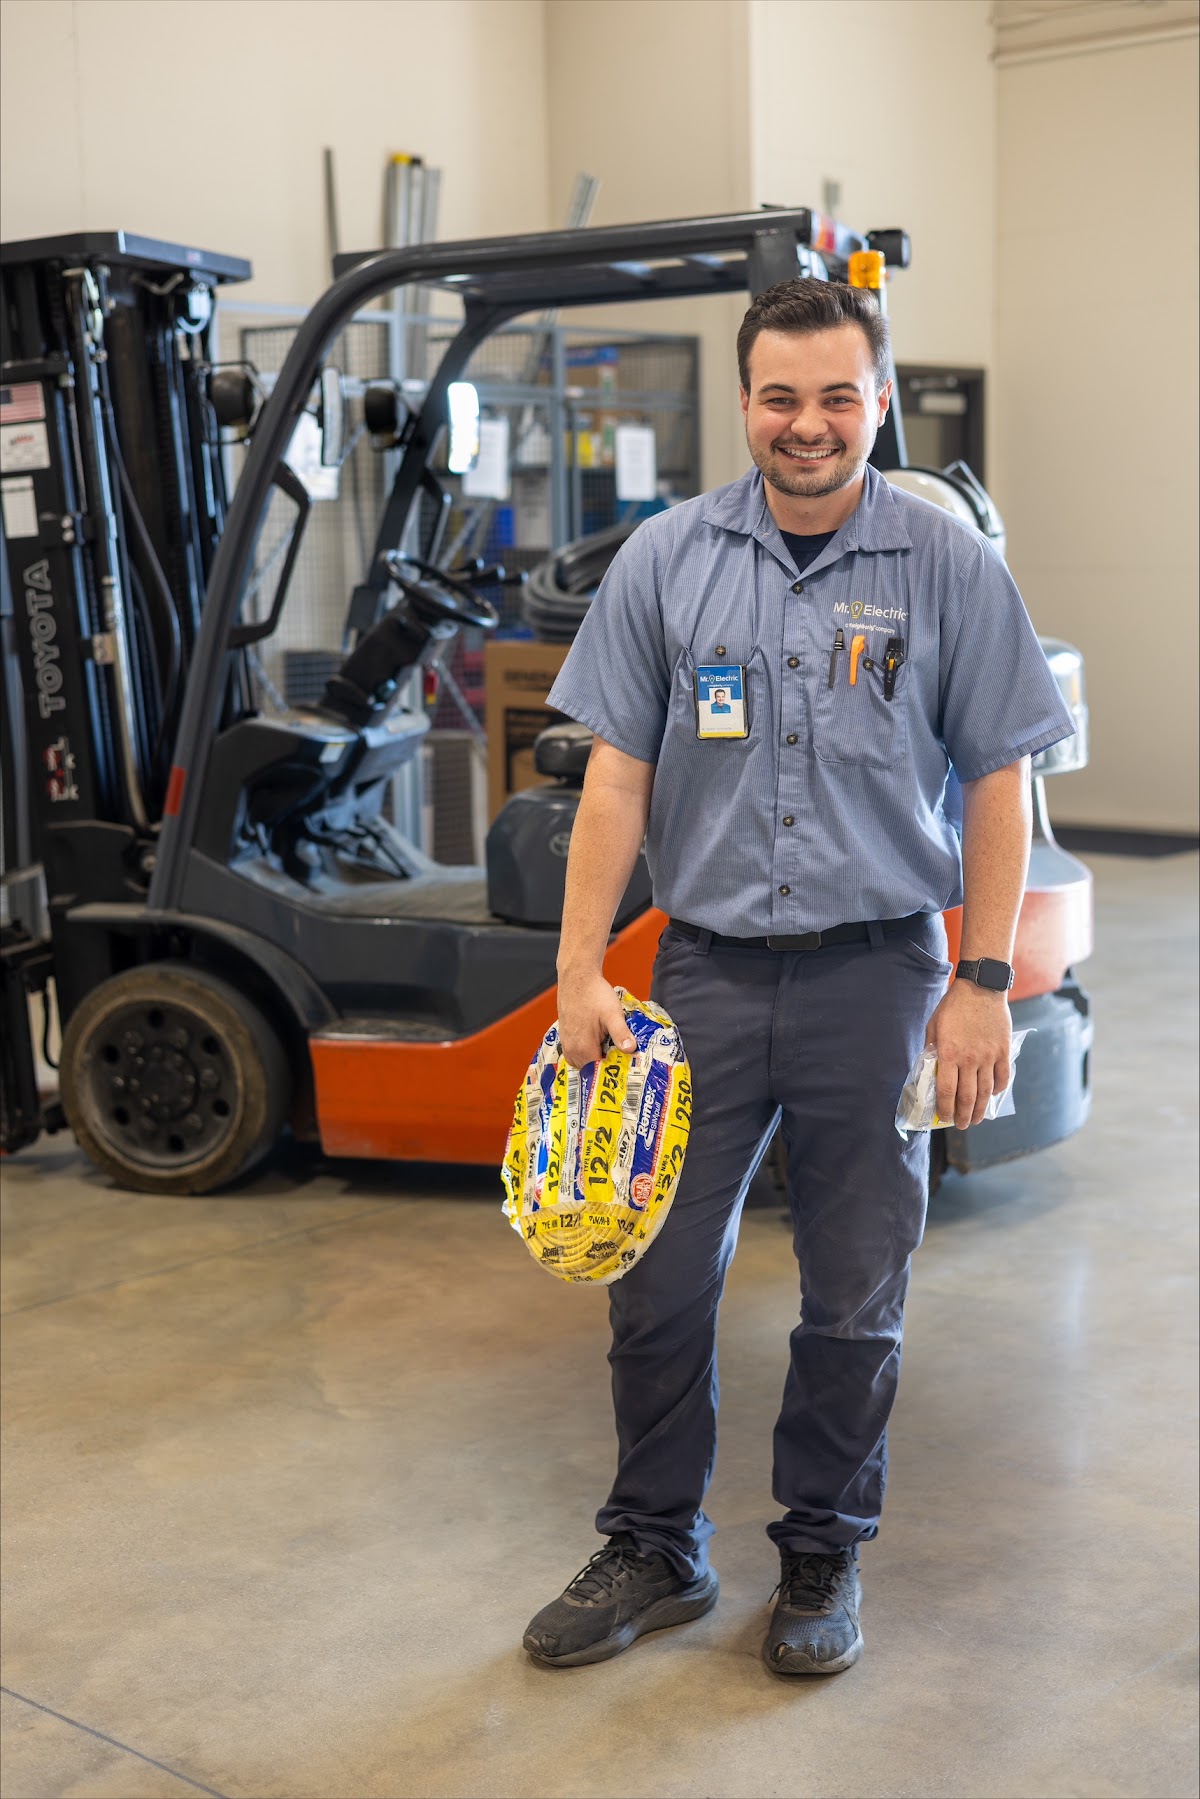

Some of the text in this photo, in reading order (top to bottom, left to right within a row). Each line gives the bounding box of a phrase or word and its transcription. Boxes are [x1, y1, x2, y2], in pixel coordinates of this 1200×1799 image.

[833, 602, 907, 621] Mr. Electric
[23, 558, 67, 719] TOYOTA
[600, 1064, 620, 1104] 250
[637, 1088, 657, 1137] Romex
[650, 1101, 662, 1130] SIMpull
[588, 1126, 613, 1185] 12/2
